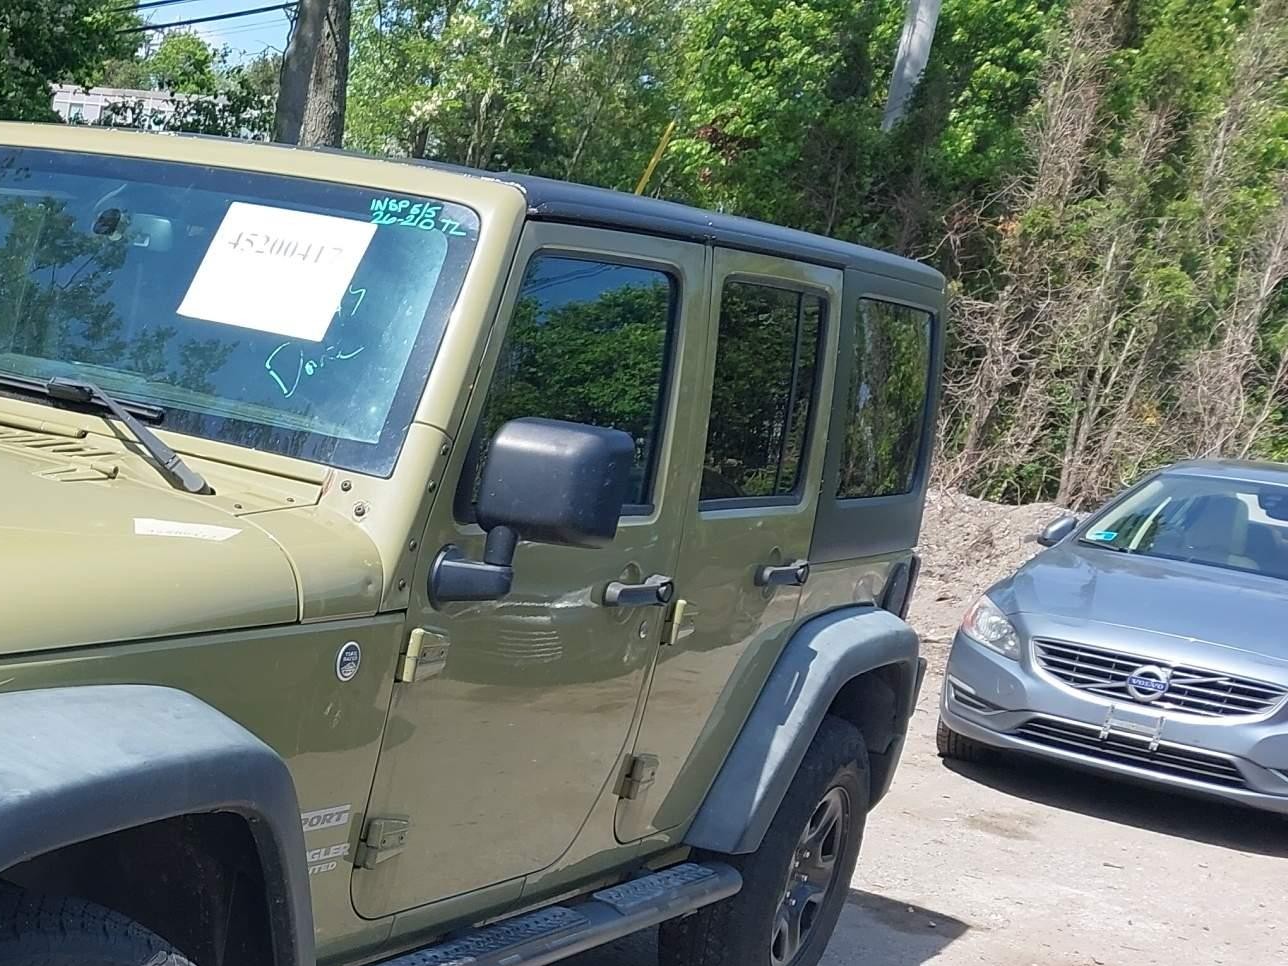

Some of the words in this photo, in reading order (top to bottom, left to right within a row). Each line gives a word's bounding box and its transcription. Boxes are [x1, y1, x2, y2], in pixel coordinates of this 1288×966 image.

[1132, 678, 1164, 690] VOLVO
[302, 811, 345, 827] PORT
[307, 843, 350, 862] GLER
